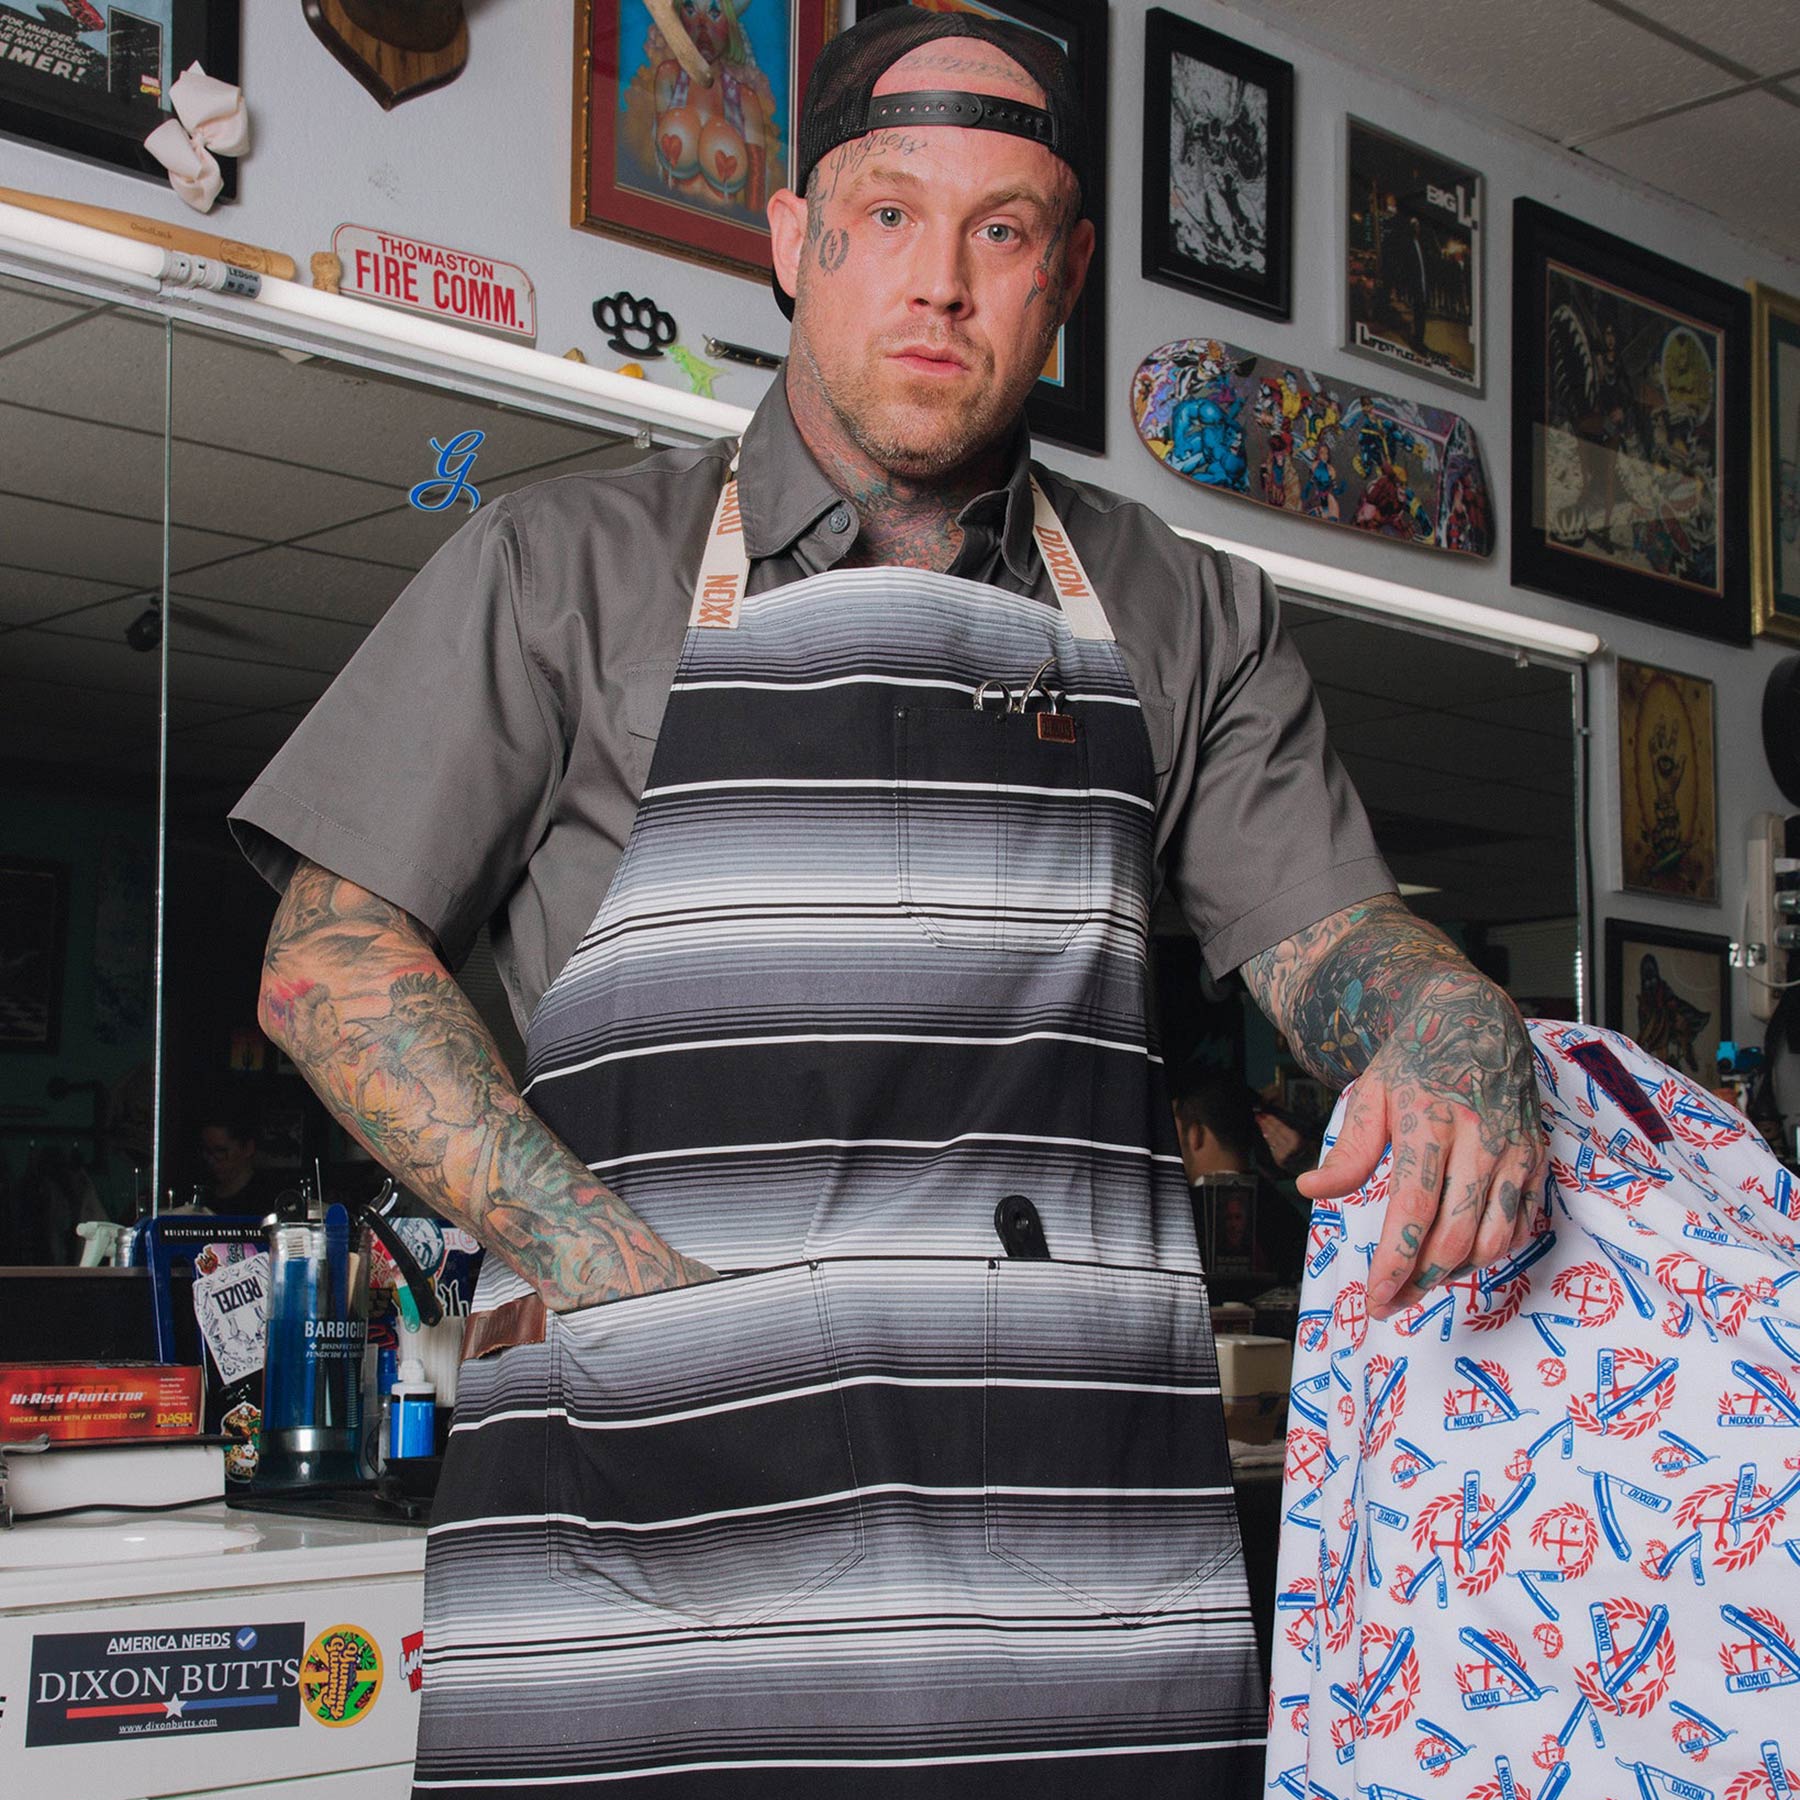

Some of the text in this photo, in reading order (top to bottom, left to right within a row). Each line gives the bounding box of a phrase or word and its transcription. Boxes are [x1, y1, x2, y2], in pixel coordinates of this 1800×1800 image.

[1426, 184, 1456, 214] BIG
[377, 235, 494, 280] THOMASTON
[355, 249, 524, 328] FIRE COMM.
[1035, 524, 1090, 597] DIXXON
[1693, 1227, 1728, 1243] DIXXON
[1313, 1241, 1337, 1271] DIXXON
[211, 1276, 263, 1314] REUZEL
[1601, 1356, 1612, 1386] DIXXON
[66, 1390, 144, 1403] PROTECTOR
[156, 1412, 193, 1424] DASH
[1454, 1414, 1484, 1426] DIXXON
[1728, 1416, 1765, 1425] DIXXON
[1466, 1480, 1478, 1512] DIXXON
[1628, 1488, 1662, 1508] DIXXON
[106, 1632, 230, 1653] AMERICA NEEDS
[1594, 1613, 1611, 1651] DIXXON
[36, 1658, 300, 1703] DIXON BUTTS
[1736, 1672, 1771, 1688] DIXXON
[1469, 1691, 1500, 1705] DIXXON
[118, 1717, 218, 1733] www.dixonbutts.com
[1766, 1753, 1787, 1791] DIXXON
